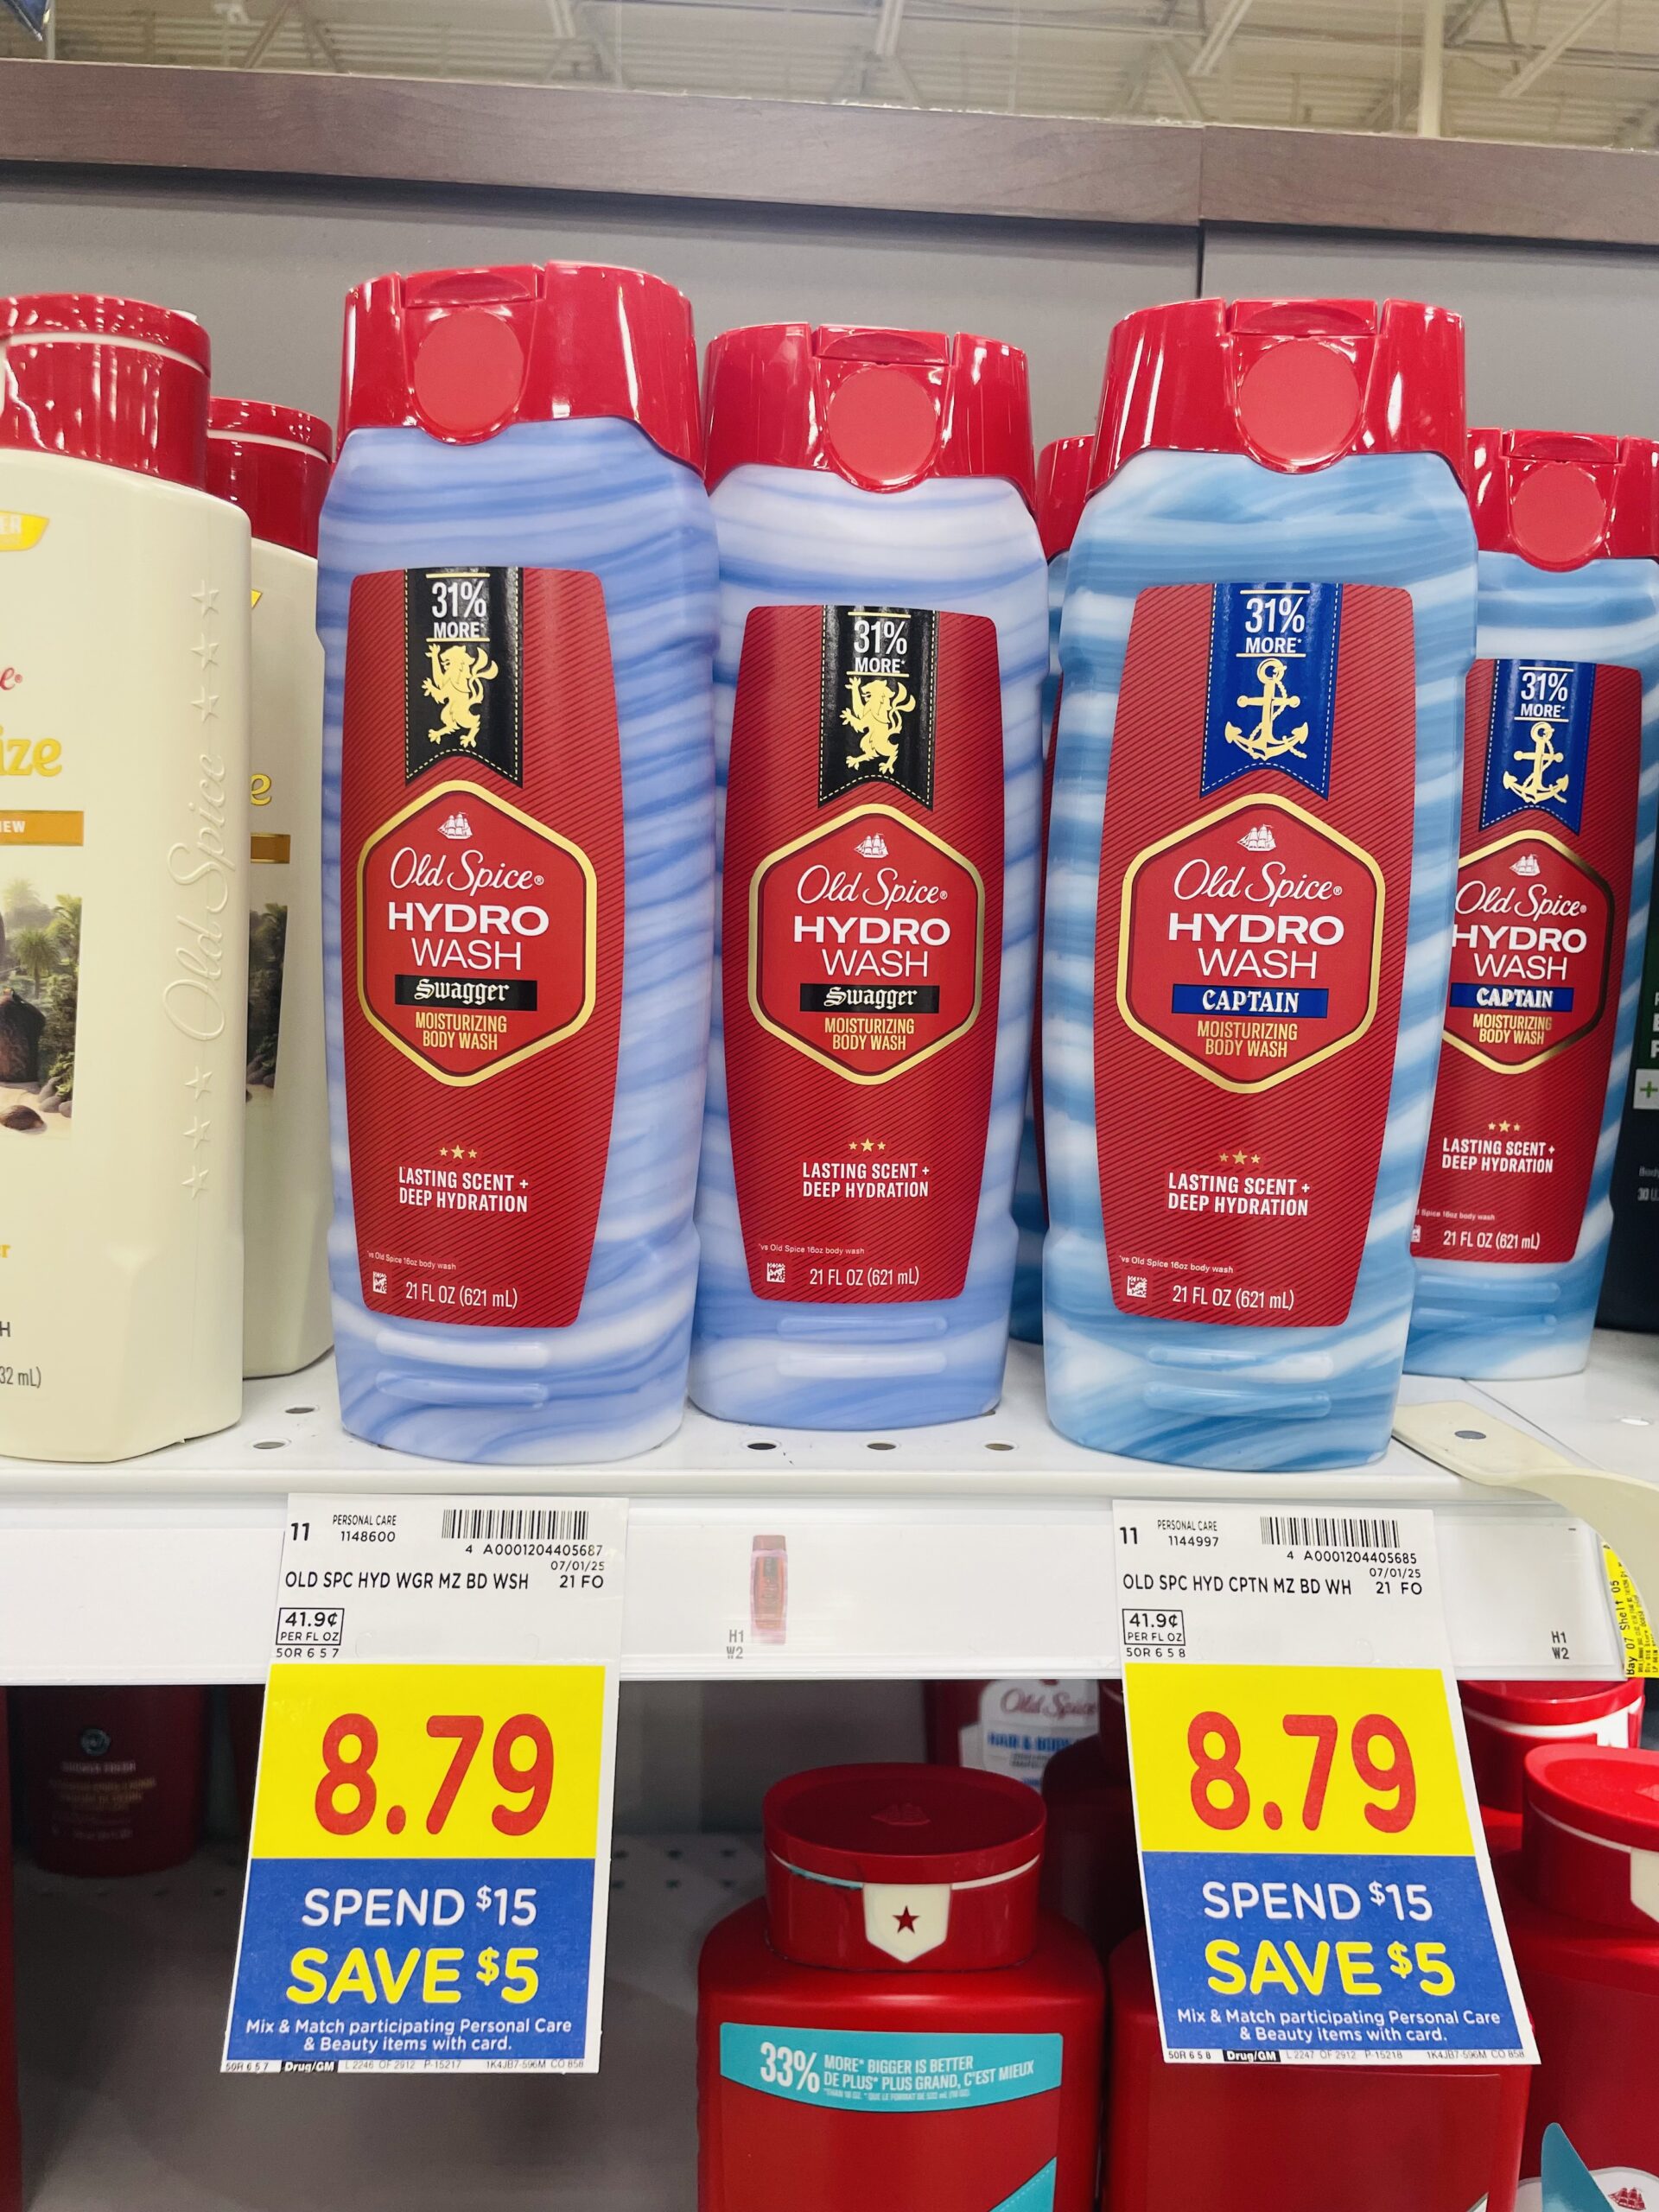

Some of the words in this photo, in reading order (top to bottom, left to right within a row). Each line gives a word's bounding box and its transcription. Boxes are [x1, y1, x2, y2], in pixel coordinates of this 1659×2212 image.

[431, 582, 486, 619] 31%
[1245, 597, 1305, 633] 31%
[853, 620, 907, 655] 31%
[1521, 671, 1568, 702] 31%
[167, 754, 235, 913] Spice
[391, 847, 447, 889] Old
[797, 864, 862, 904] Old
[1173, 858, 1246, 900] Old
[1455, 880, 1516, 914] Old
[388, 901, 550, 937] HYDRO
[1168, 912, 1344, 946] HYDRO
[793, 916, 950, 946] HYDRO
[1452, 924, 1587, 953] HYDRO
[410, 938, 522, 970] WASH
[822, 949, 928, 977] WASH
[1198, 948, 1318, 979] WASH
[1473, 952, 1567, 981] WASH
[162, 915, 223, 1044] Old
[414, 978, 510, 1005] Swagger
[823, 986, 918, 1010] Swagger
[1202, 989, 1299, 1014] CAPTAIN
[1476, 987, 1554, 1008] CAPTAIN
[824, 1018, 915, 1034] MOISTURIZING
[1197, 1020, 1298, 1041] MOISTURIZING
[1472, 1013, 1553, 1031] MOISTURIZING
[832, 1035, 866, 1051] BODY
[870, 1035, 906, 1051] WASH
[1478, 1028, 1510, 1044] BODY
[1513, 1030, 1544, 1045] WASH
[1205, 1039, 1243, 1057] BODY
[1248, 1040, 1288, 1058] WASH
[803, 1162, 867, 1179] LASTING
[872, 1163, 918, 1179] SCENT
[803, 1181, 841, 1198] DEEP
[845, 1181, 929, 1198] HYDRATION
[1168, 1172, 1238, 1193] LASTING
[1244, 1177, 1297, 1196] SCENT
[1168, 1192, 1209, 1211] DEEP
[1214, 1196, 1309, 1217] HYDRATION
[1131, 1255, 1145, 1265] Old
[1147, 1258, 1168, 1268] Spice
[1171, 1260, 1188, 1270] 16oz
[1191, 1262, 1210, 1273] body
[1212, 1265, 1234, 1274] wash
[810, 1268, 823, 1285] 21
[828, 1270, 842, 1286] FL
[846, 1269, 863, 1286] OZ
[868, 1268, 893, 1287] (621
[898, 1266, 919, 1286] mL)
[1173, 1285, 1187, 1303] 21
[1192, 1287, 1207, 1305] FL
[1212, 1288, 1231, 1306] OZ
[1236, 1287, 1264, 1309] (621
[1269, 1289, 1294, 1311] mL)
[17, 1366, 41, 1389] mL)
[333, 1515, 372, 1526] PERSONAL
[376, 1515, 397, 1526] CARE
[1157, 1519, 1196, 1530] PERSONAL
[1198, 1521, 1217, 1531] CARE
[291, 1522, 310, 1541] 11
[340, 1531, 396, 1542] 1148600
[1120, 1527, 1138, 1544] 11
[1168, 1535, 1219, 1547] 1144997
[483, 1544, 603, 1556] A0001204405687
[1304, 1550, 1417, 1564] A0001204405685
[550, 1560, 605, 1572] 07/01/25
[1370, 1567, 1421, 1579] 07/01/25
[285, 1572, 318, 1587] OLD
[323, 1572, 353, 1588] SPC
[359, 1573, 390, 1589] HYD
[397, 1573, 434, 1589] WGR
[439, 1573, 461, 1589] MZ
[467, 1573, 487, 1589] BD
[493, 1573, 529, 1589] WSH
[559, 1574, 575, 1588] 21
[582, 1575, 604, 1589] FO
[1123, 1573, 1154, 1589] OLD
[1160, 1574, 1187, 1591] SPC
[1192, 1575, 1224, 1591] HYD
[1229, 1577, 1268, 1592] CPTN
[1274, 1578, 1295, 1593] MZ
[1300, 1579, 1320, 1594] BD
[1325, 1579, 1351, 1595] WH
[1376, 1581, 1390, 1594] 21
[1402, 1582, 1422, 1595] FO
[285, 1611, 338, 1627] 41.9¢
[1129, 1612, 1178, 1628] 41.9¢
[1615, 1600, 1630, 1630] Shelf
[280, 1631, 302, 1641] PER
[306, 1631, 319, 1641] FL
[322, 1631, 339, 1642] OZ
[728, 1629, 744, 1643] H1
[1128, 1632, 1147, 1641] PER
[1151, 1632, 1164, 1642] FL
[1167, 1632, 1183, 1642] OZ
[1551, 1630, 1567, 1643] H1
[1624, 1637, 1636, 1649] 07
[727, 1646, 744, 1659] W2
[1552, 1647, 1570, 1660] W2
[1625, 1656, 1638, 1675] Bay
[315, 1713, 555, 1836] 8.79
[1187, 1711, 1416, 1834] 8.79
[301, 1887, 466, 1927] SPEND
[475, 1885, 537, 1927] $15
[1202, 1880, 1362, 1920] SPEND
[1370, 1880, 1433, 1921] $15
[286, 1947, 465, 2005] SAVE
[475, 1946, 539, 2005] $5
[1205, 1939, 1382, 1996] SAVE
[1387, 1941, 1455, 1996] $5
[246, 2018, 275, 2034] Mix
[296, 2018, 345, 2034] Match
[349, 2018, 455, 2036] participating
[460, 2018, 530, 2033] Personal
[534, 2018, 572, 2032] Care
[1177, 2008, 1206, 2023] Mix
[1226, 2009, 1275, 2024] Match
[1281, 2009, 1384, 2027] participating
[1389, 2010, 1459, 2024] Personal
[1463, 2010, 1500, 2024] Care
[320, 2037, 378, 2054] Beauty
[383, 2036, 427, 2051] items
[432, 2036, 467, 2050] with
[471, 2036, 512, 2050] card.
[1255, 2027, 1313, 2044] Beauty
[1318, 2026, 1362, 2041] items
[1366, 2027, 1402, 2041] with
[1406, 2027, 1447, 2041] card.
[1226, 2050, 1277, 2062] Drug/GM
[760, 2042, 820, 2094] 33%
[868, 2058, 912, 2075] BIGGER
[915, 2058, 927, 2074] IS
[930, 2055, 974, 2072] BETTER
[823, 2071, 840, 2088] DE
[881, 2075, 912, 2091] PLUS
[915, 2074, 961, 2091] GRAND,
[999, 2059, 1034, 2081] MIEUX
